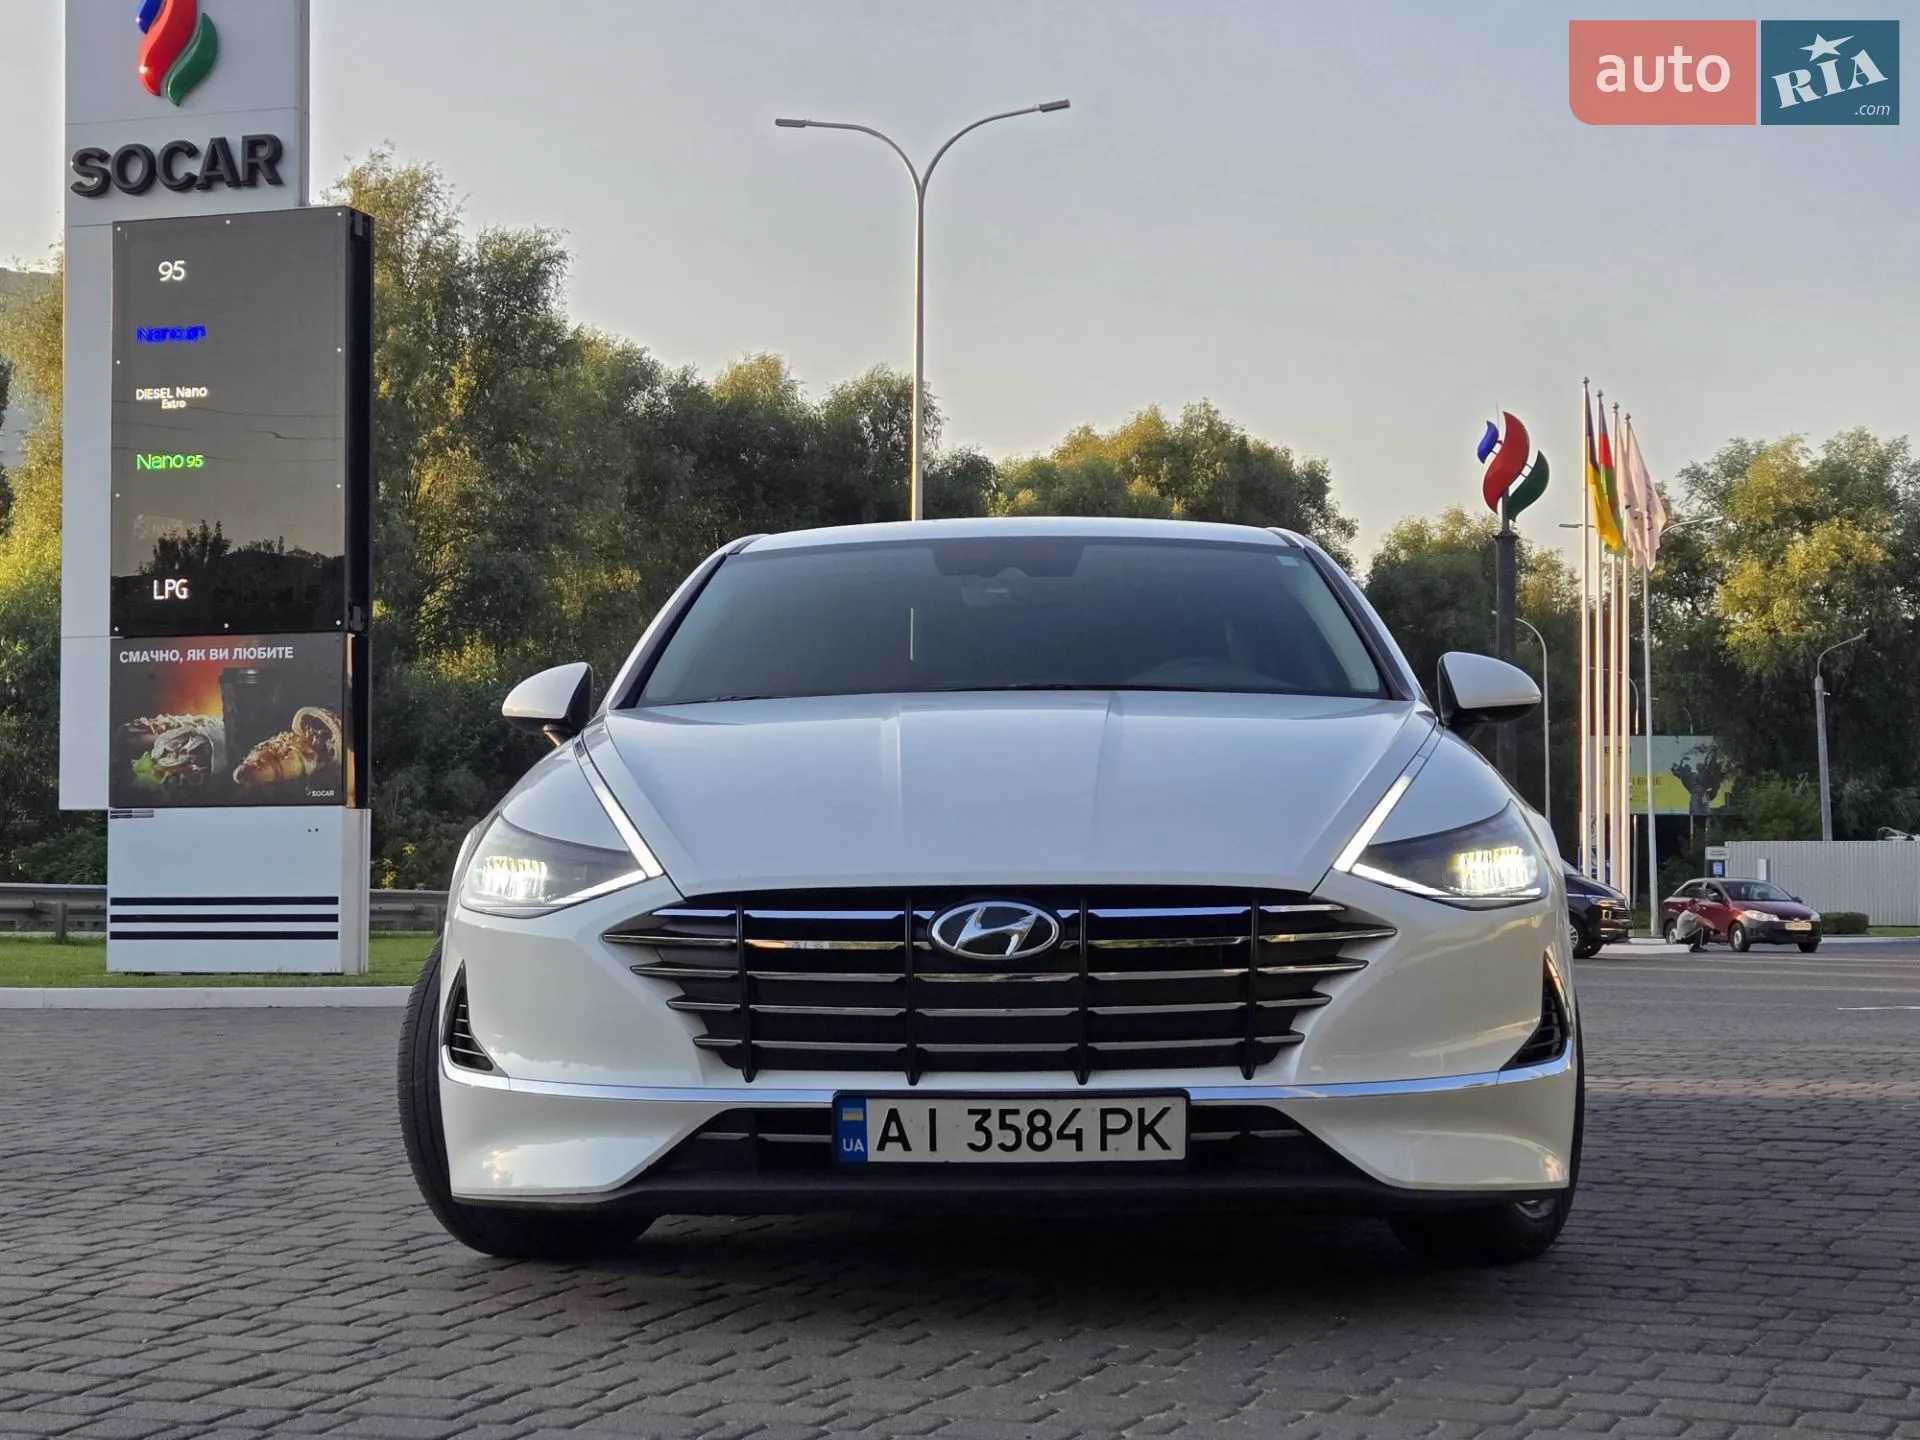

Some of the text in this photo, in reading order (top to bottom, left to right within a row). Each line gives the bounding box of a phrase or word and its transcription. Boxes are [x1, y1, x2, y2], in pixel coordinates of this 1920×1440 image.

[70, 133, 284, 198] SOCAR
[158, 260, 186, 282] 95
[135, 386, 208, 401] DIESEL Nano
[136, 453, 205, 470] Nano 95
[153, 578, 188, 600] LPG
[119, 646, 294, 664] СМАЧНО, ЯК ВИ ЛЮБИТЕ
[876, 1107, 938, 1152] AI
[842, 1138, 865, 1152] UA
